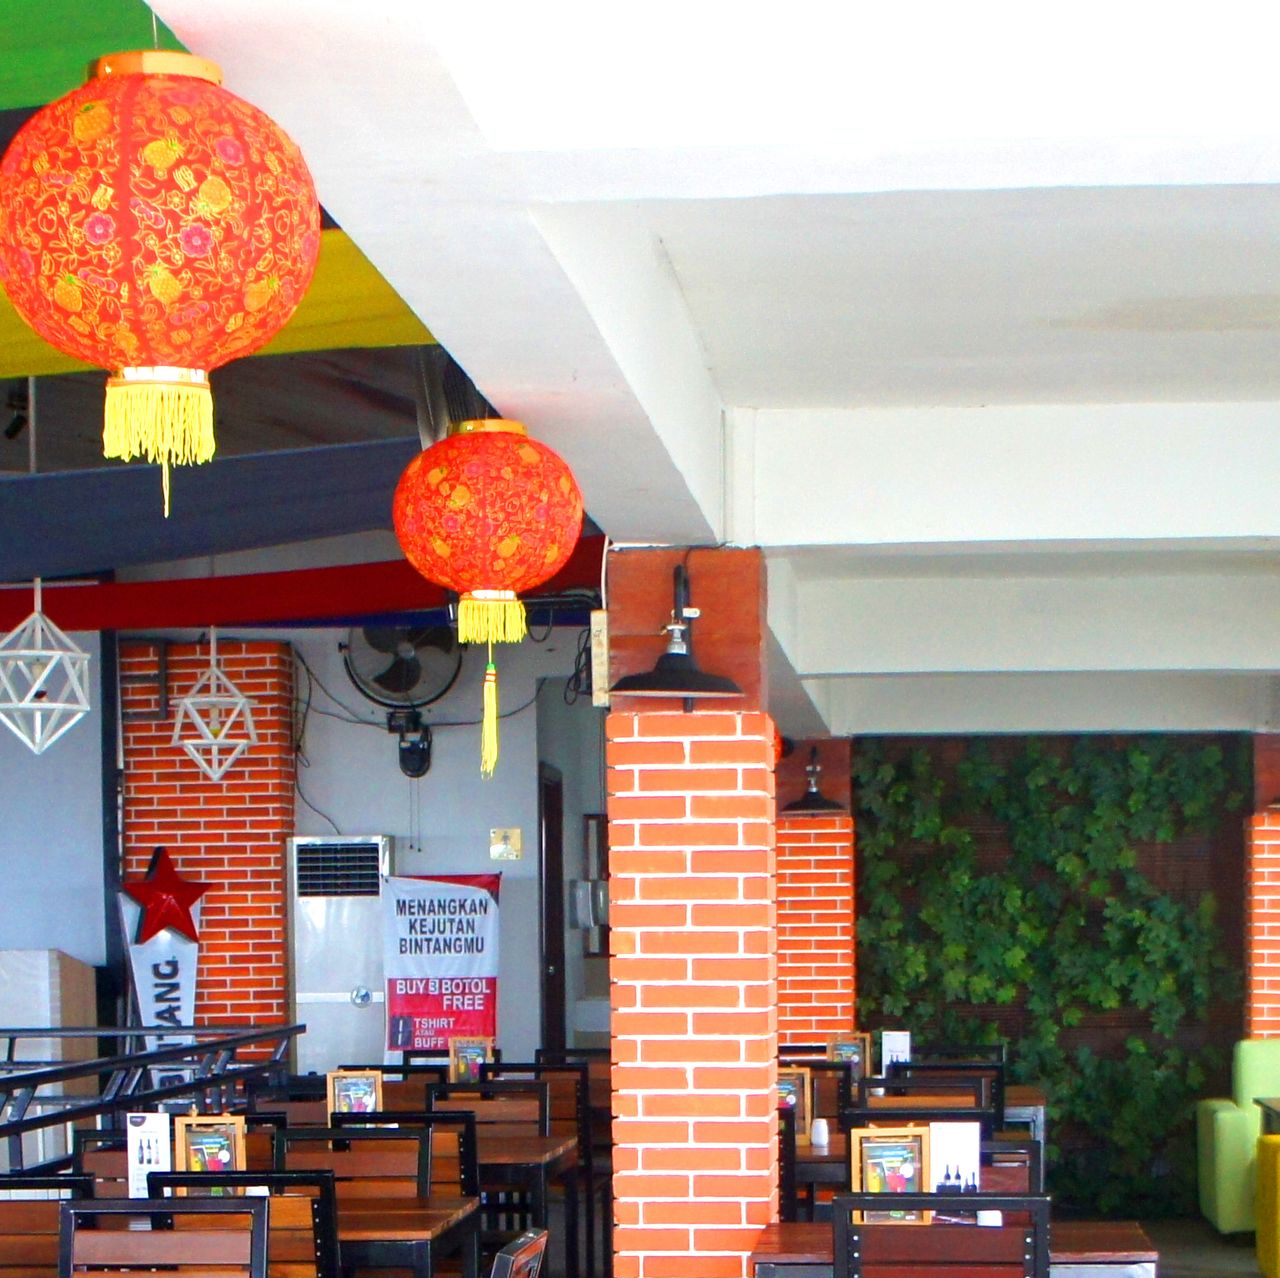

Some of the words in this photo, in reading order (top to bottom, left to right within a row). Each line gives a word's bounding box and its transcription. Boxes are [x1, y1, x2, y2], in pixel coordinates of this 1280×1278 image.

[396, 899, 488, 916] MENANGKAN
[408, 918, 475, 935] KEJUTAN
[399, 937, 484, 954] BINTANGMU
[396, 979, 426, 994] BUY
[441, 979, 491, 994] BOTOL
[443, 995, 484, 1010] FREE
[413, 1018, 455, 1029] TSHIRT
[414, 1037, 445, 1048] BUFF
